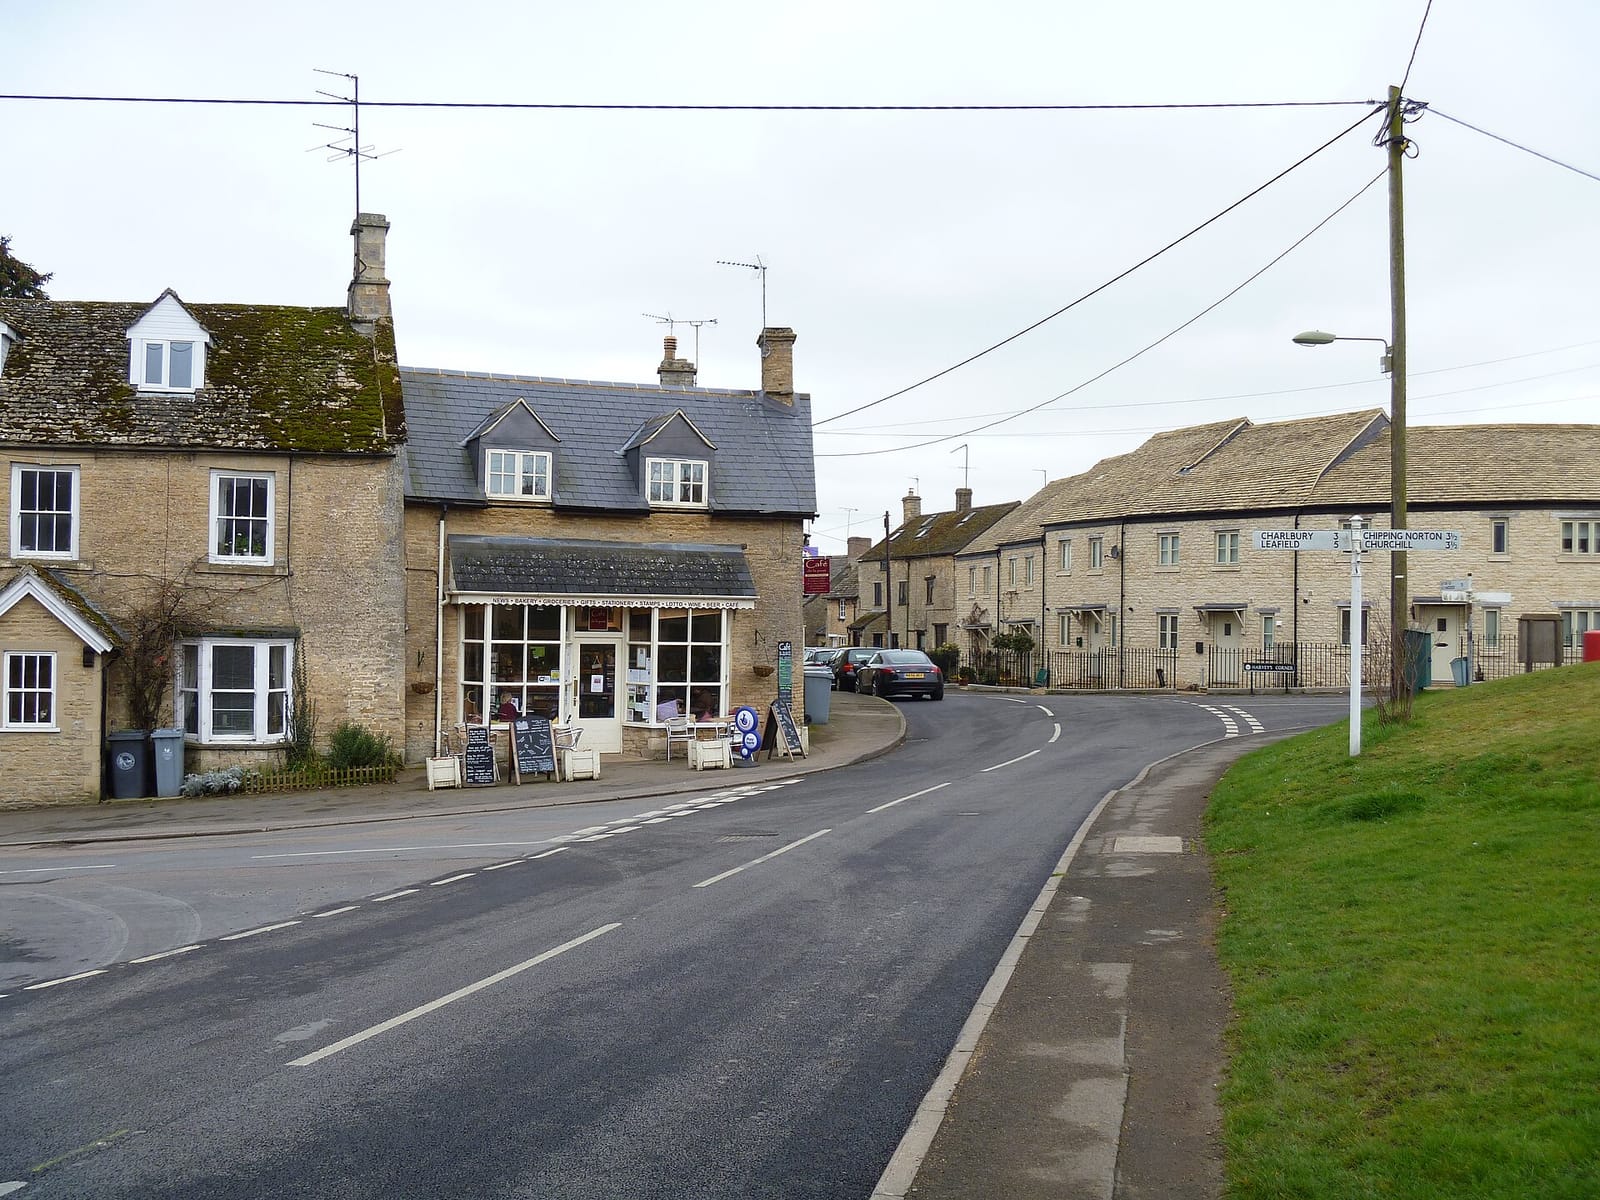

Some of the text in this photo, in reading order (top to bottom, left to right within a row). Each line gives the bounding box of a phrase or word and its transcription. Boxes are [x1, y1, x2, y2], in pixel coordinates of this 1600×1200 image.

[1261, 532, 1339, 540] CHARLBURY 3
[1363, 532, 1403, 540] CHIPPING
[1405, 532, 1442, 540] NORTON
[1261, 540, 1300, 548] LEAFIELD
[1365, 541, 1413, 549] CHURCHILL
[805, 559, 828, 569] Café
